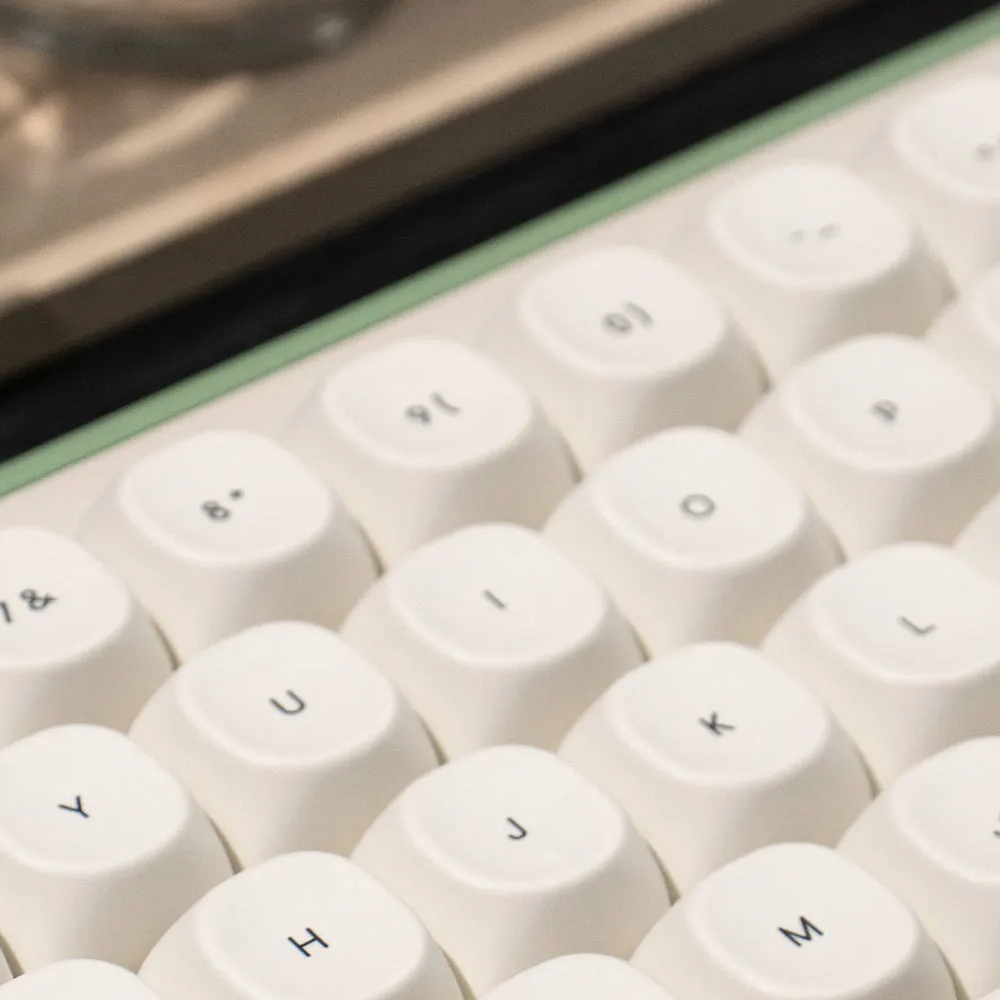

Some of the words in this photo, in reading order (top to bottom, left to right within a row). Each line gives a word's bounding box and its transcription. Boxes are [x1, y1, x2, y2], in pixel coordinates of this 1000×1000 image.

[678, 493, 717, 520] O
[899, 616, 937, 637] L
[269, 689, 307, 716] U
[699, 712, 734, 736] K
[58, 795, 90, 819] Y
[506, 817, 528, 841] J
[287, 927, 329, 958] H
[777, 915, 824, 948] M
